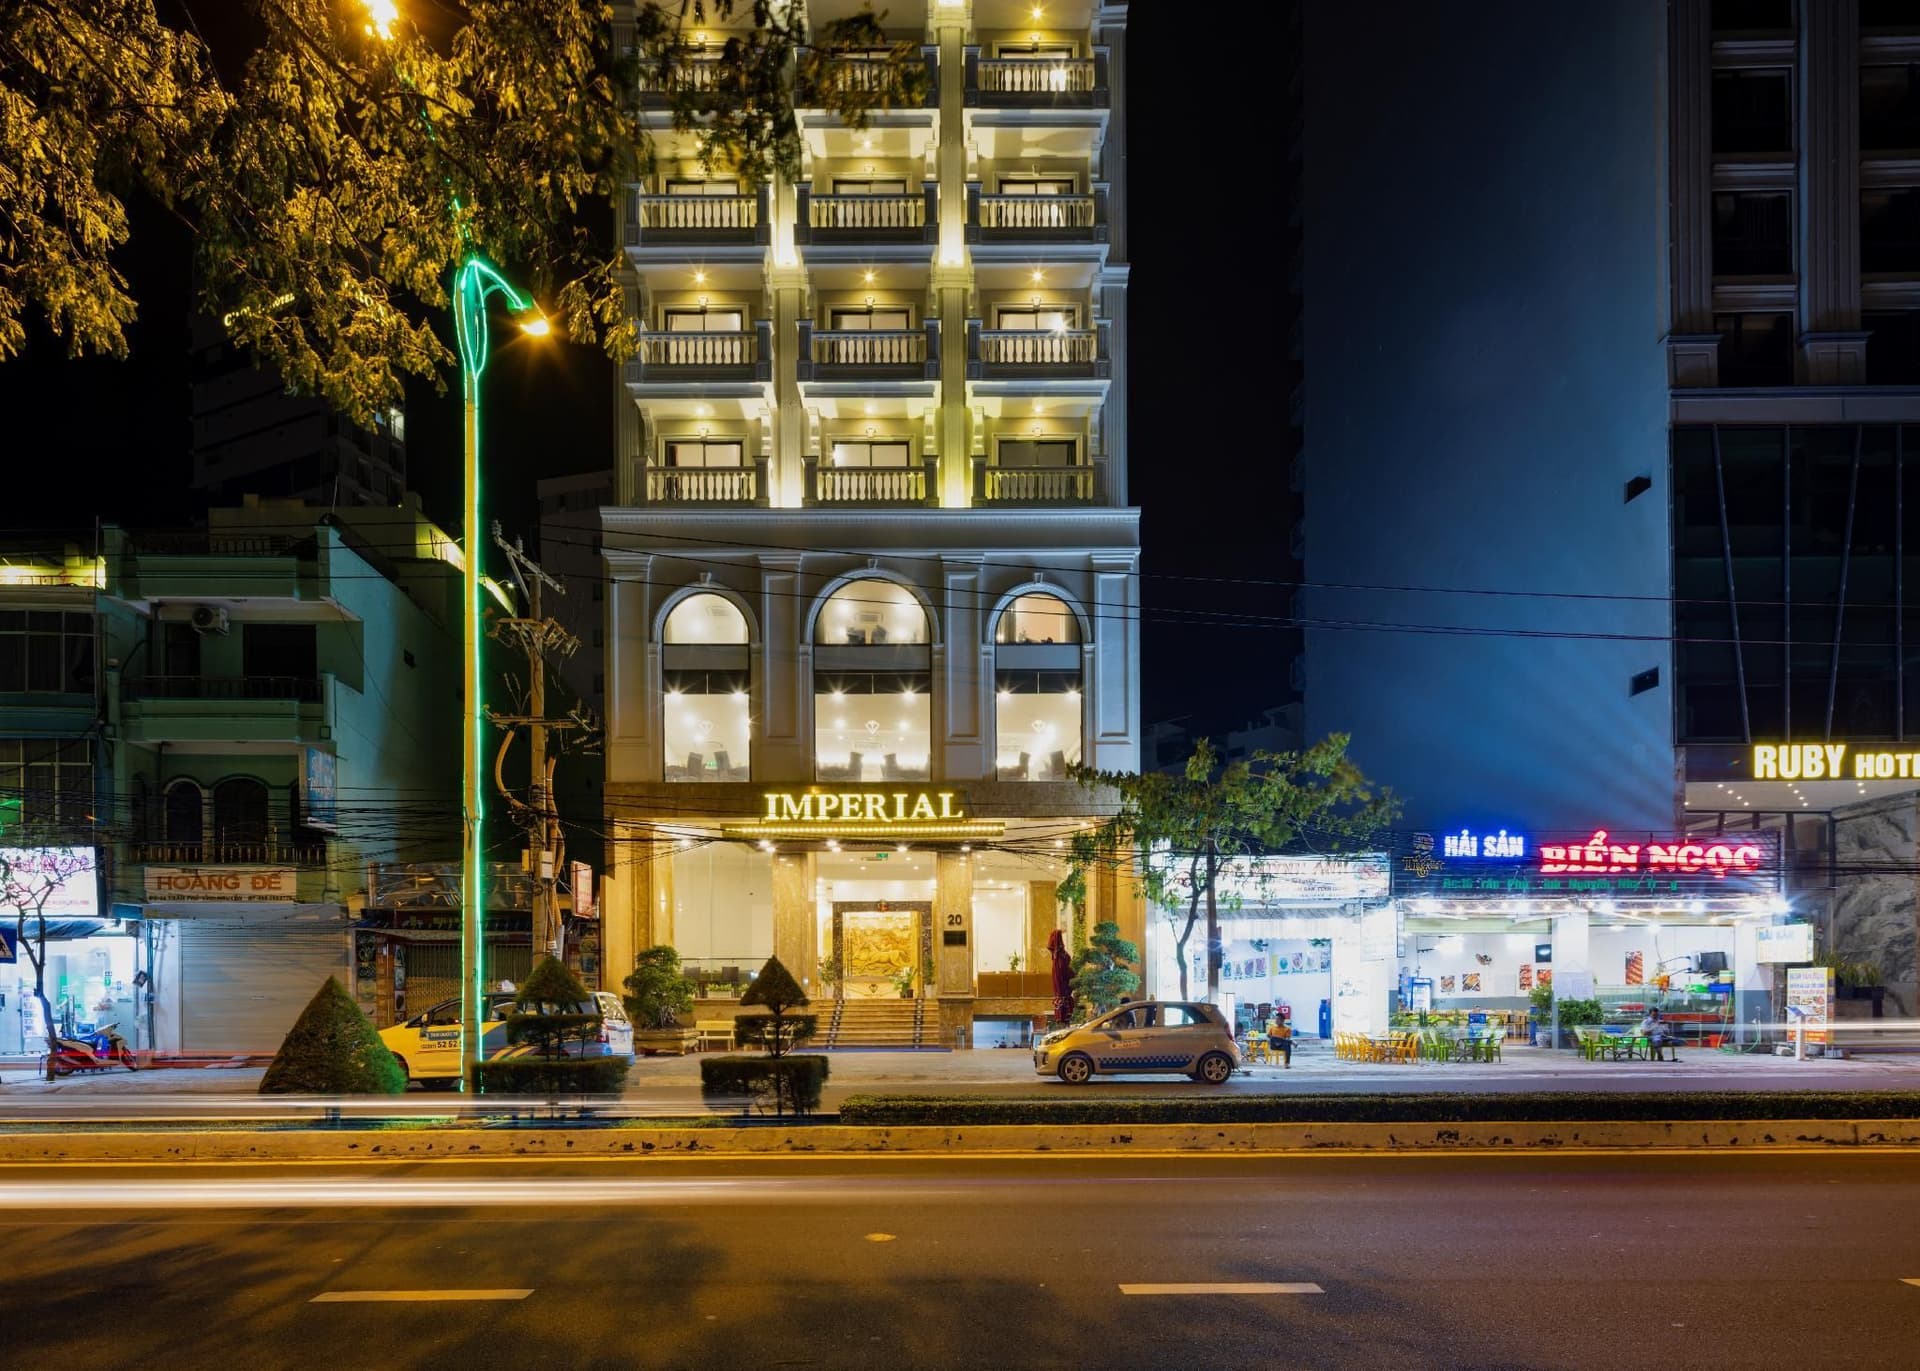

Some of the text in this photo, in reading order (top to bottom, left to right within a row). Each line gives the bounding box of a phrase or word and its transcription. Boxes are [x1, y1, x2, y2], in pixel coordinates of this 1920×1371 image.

[1754, 744, 1846, 779] RUBY
[764, 793, 963, 822] IMPERIAL
[1444, 829, 1524, 857] HẢI SẢN
[1540, 830, 1760, 878] BIỂN NGỌC
[157, 868, 282, 890] HOÀNG ĐẾ
[947, 914, 962, 926] 20
